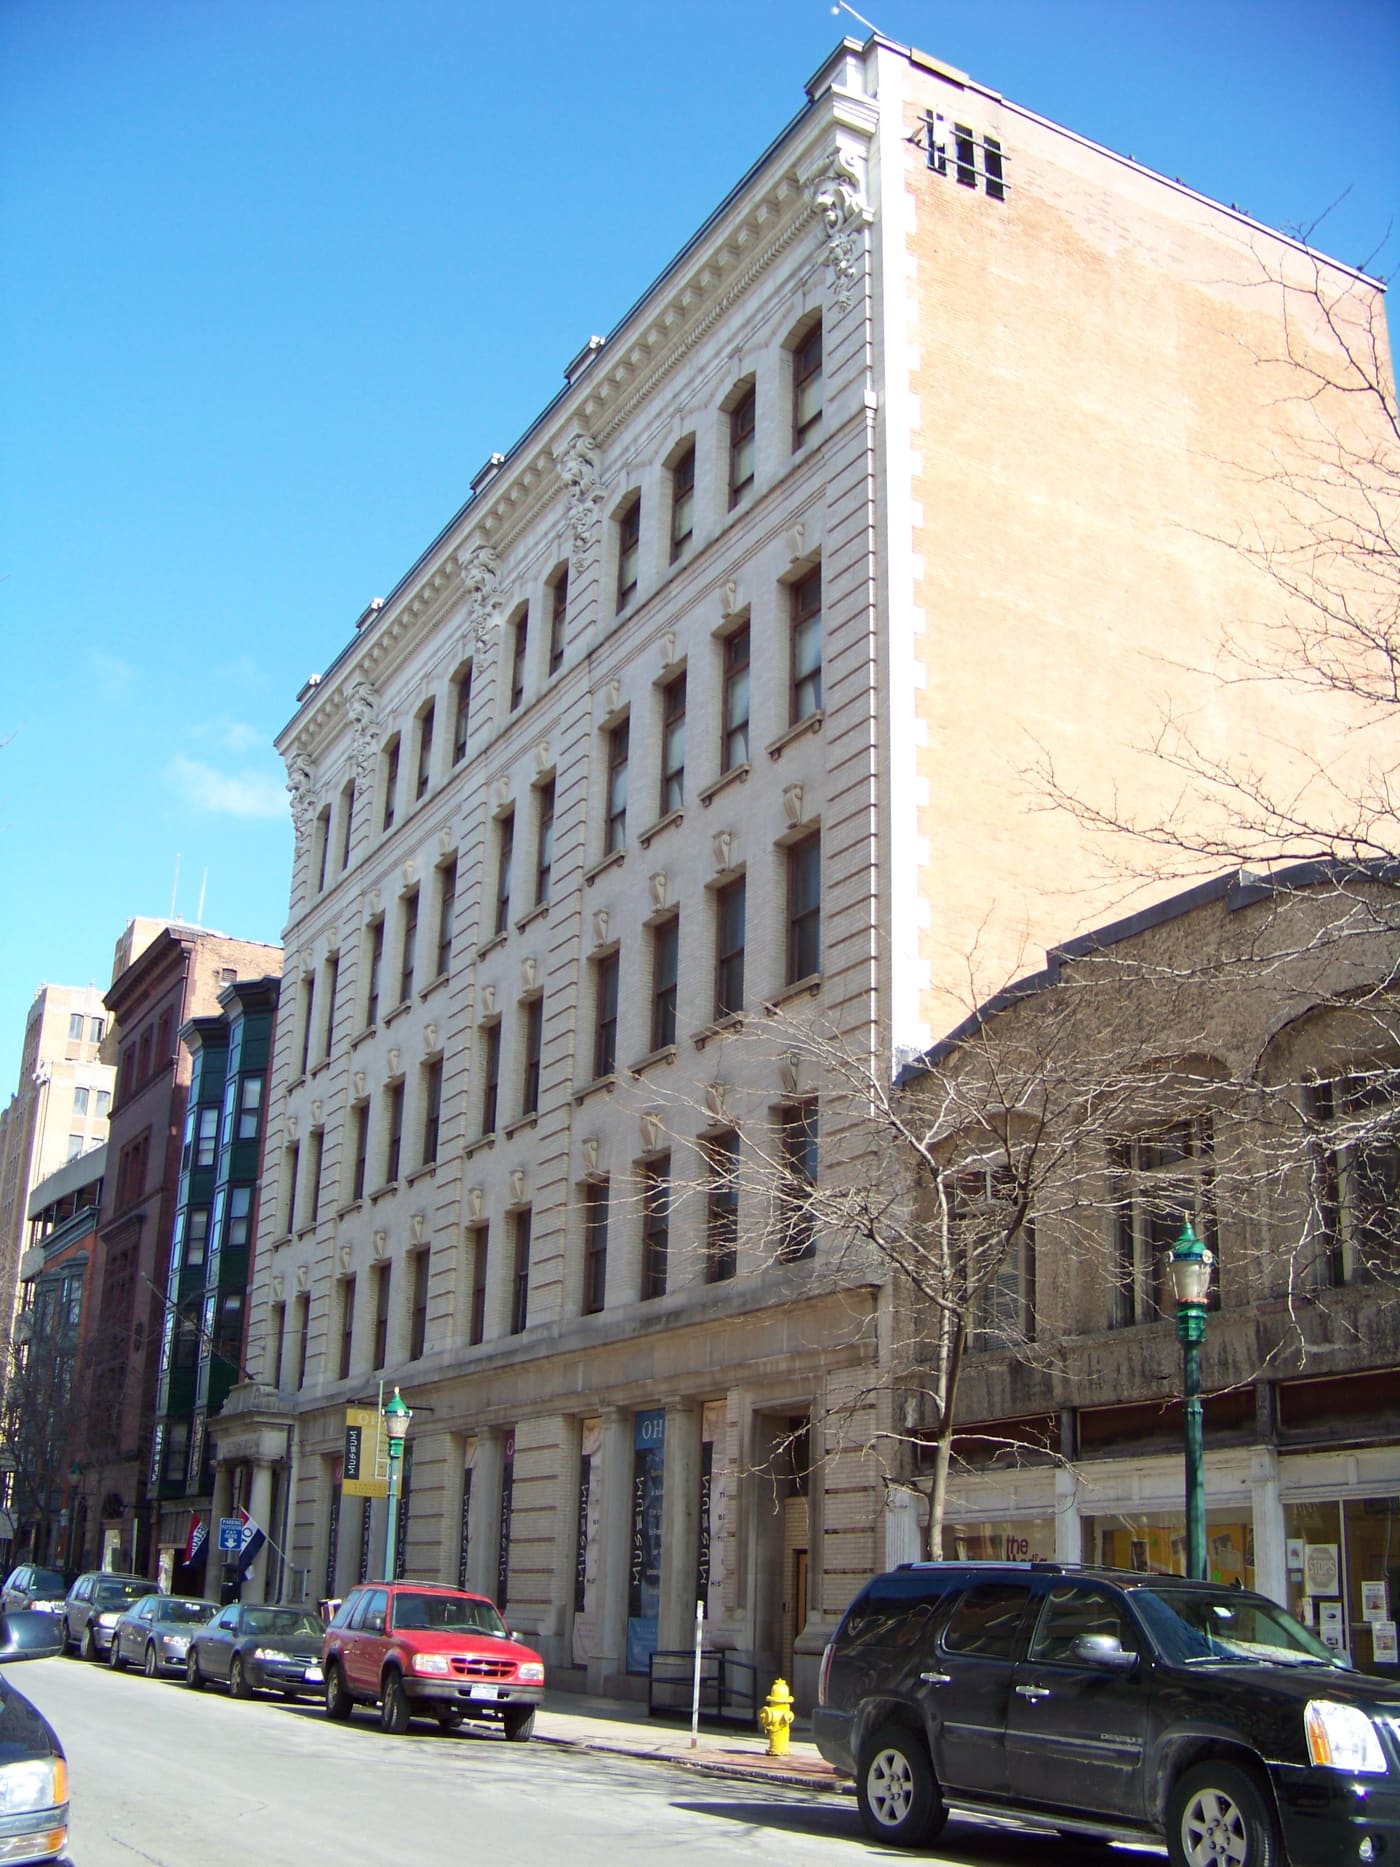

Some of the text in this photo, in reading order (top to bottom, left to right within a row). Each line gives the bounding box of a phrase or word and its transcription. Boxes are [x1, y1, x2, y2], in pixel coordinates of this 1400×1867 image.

[642, 1420, 663, 1439] OH
[347, 1431, 358, 1474] MUSEUM
[577, 1485, 589, 1581] MUSEUM
[632, 1477, 645, 1585] MUSEUM
[699, 1475, 711, 1584] MUSEUM
[1006, 1535, 1029, 1554] the
[1308, 1559, 1336, 1576] STOPS
